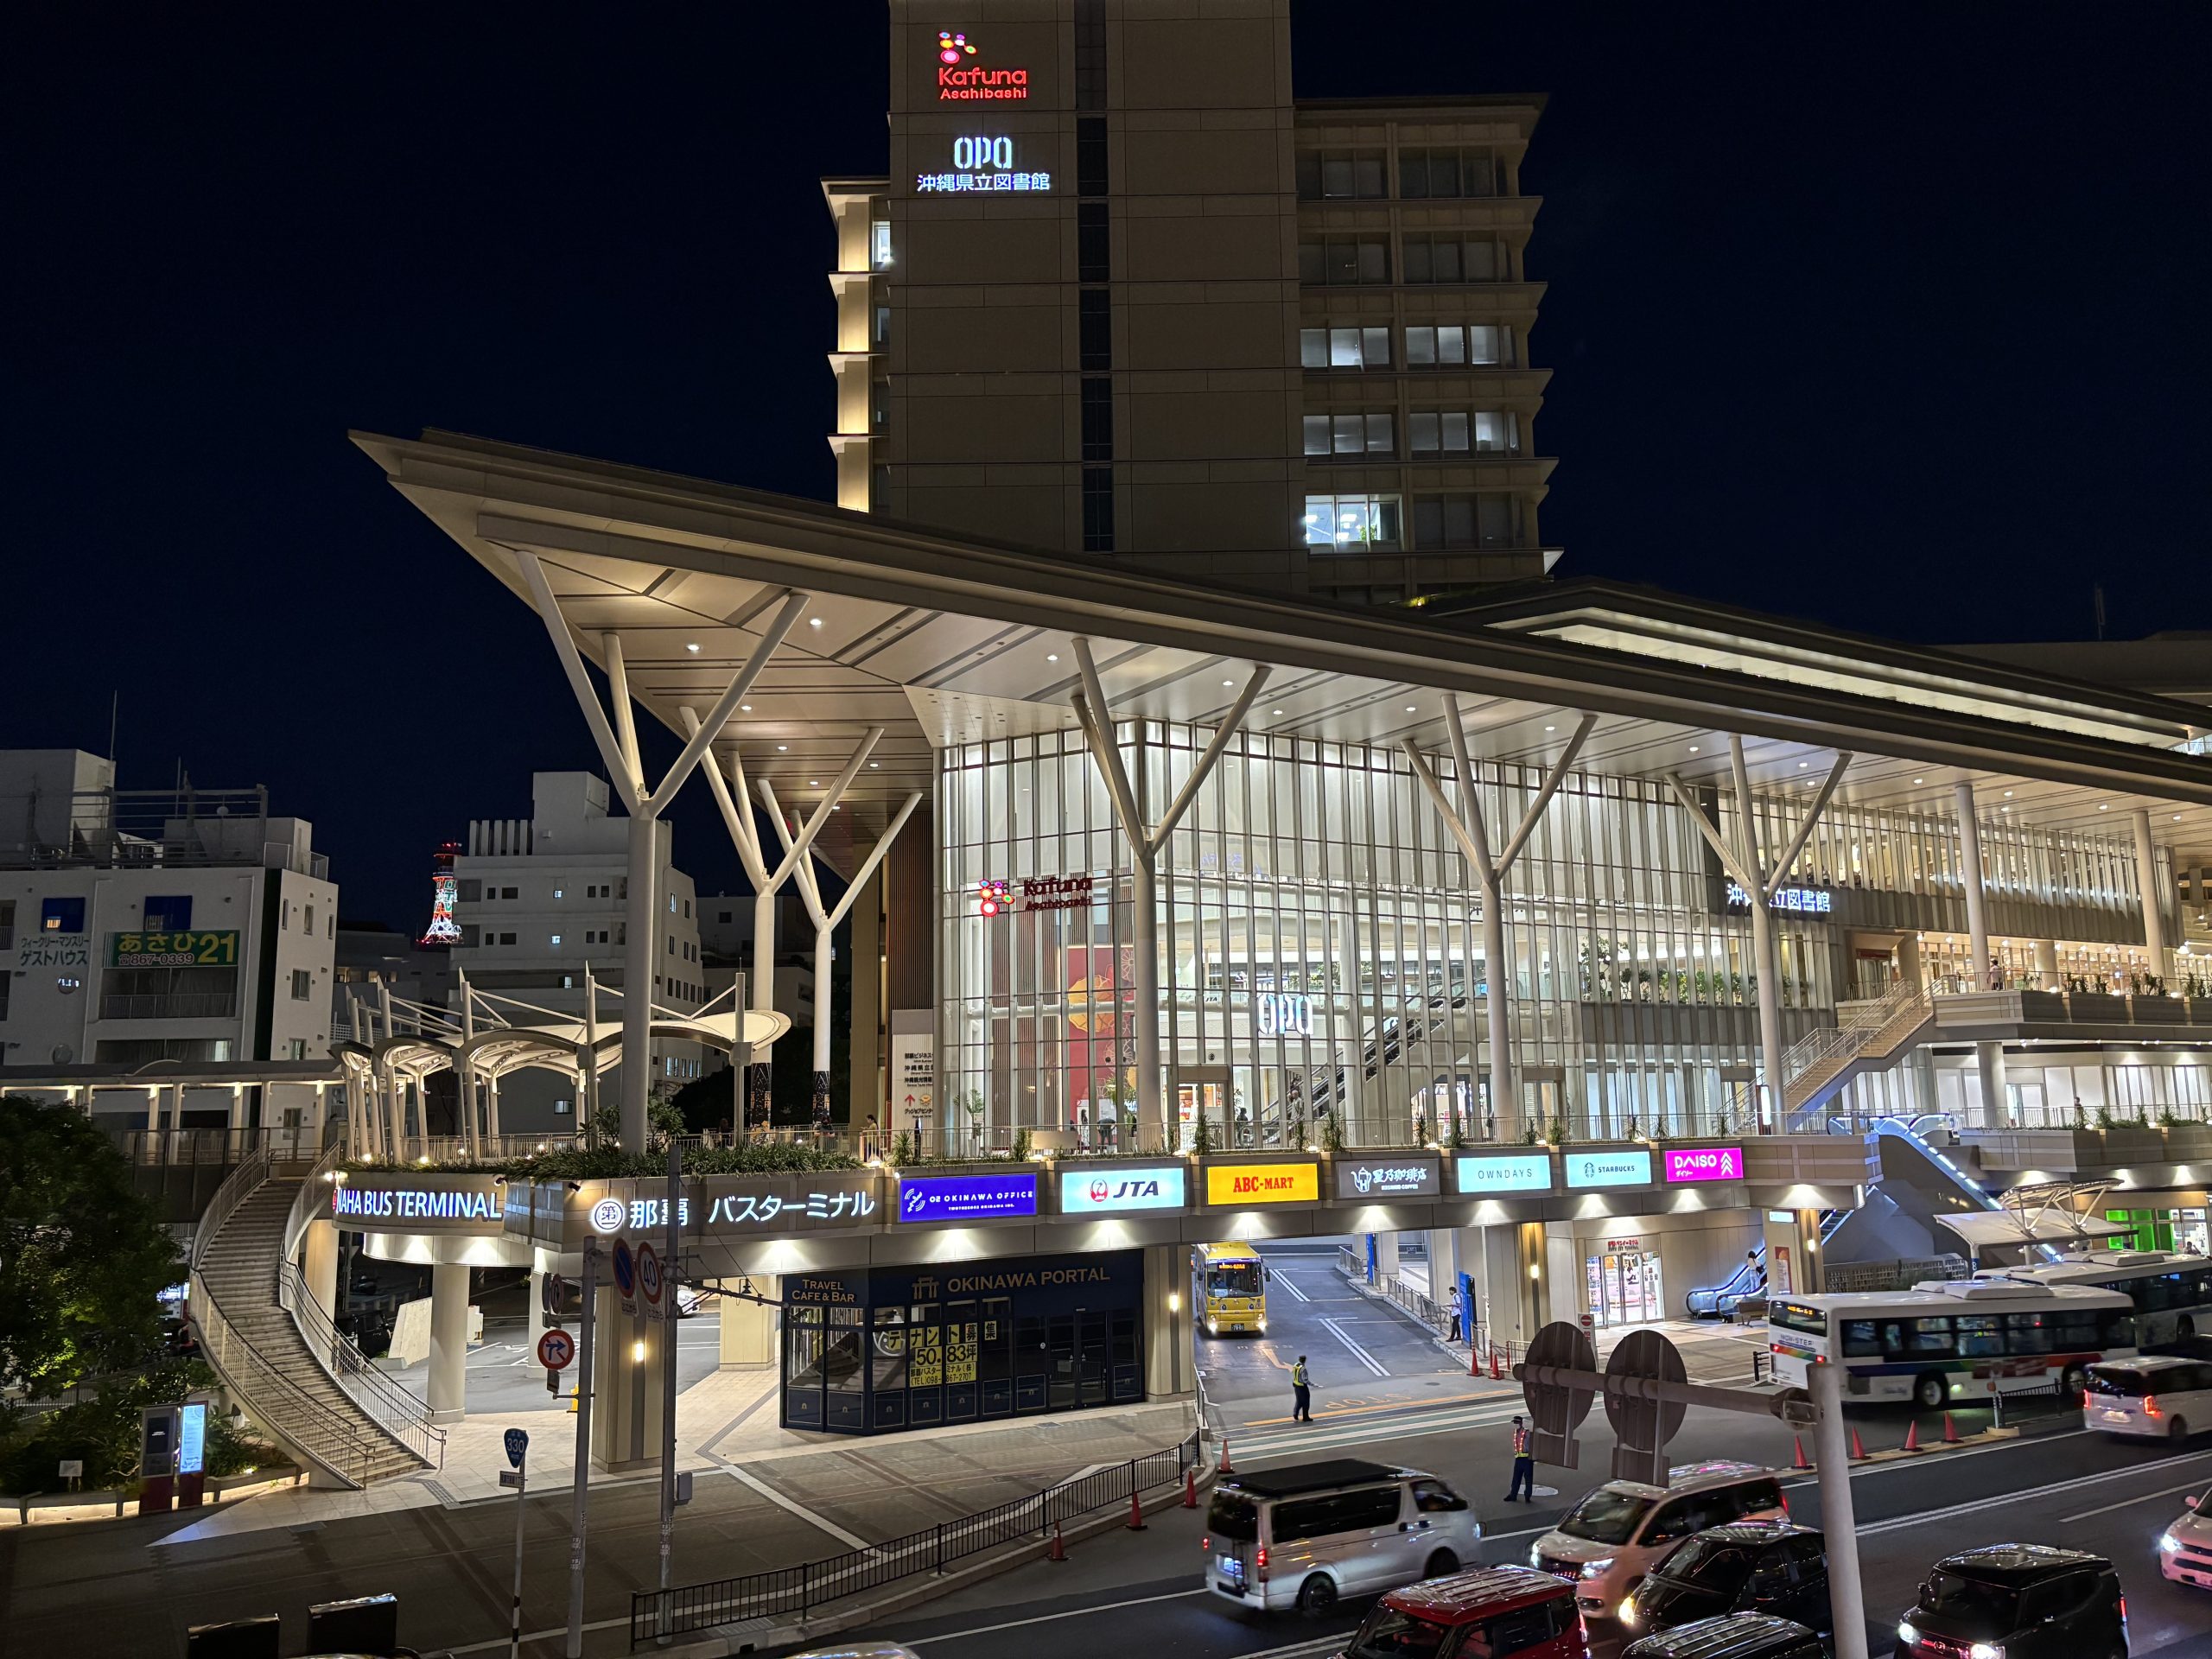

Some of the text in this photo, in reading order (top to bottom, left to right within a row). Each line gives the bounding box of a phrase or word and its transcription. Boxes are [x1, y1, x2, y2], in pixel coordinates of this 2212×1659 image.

[938, 67, 1027, 86] Kafuna
[940, 87, 1027, 99] Asahibashi
[917, 173, 1050, 192] 沖縄県立図書館
[1024, 877, 1092, 896] Kafuna
[1727, 883, 1830, 912] 沖立図書館
[21, 950, 87, 966] ゲストハウス
[1598, 1165, 1635, 1173] STARBUCKS
[1674, 1154, 1717, 1168] DAISO
[1478, 1169, 1533, 1180] OWNDAYS
[1113, 1180, 1159, 1198] JTA
[1233, 1175, 1294, 1193] ABC-MART
[337, 1188, 361, 1214] NAHA
[365, 1191, 392, 1216] BUS
[396, 1192, 502, 1218] TERMINAL
[944, 1193, 993, 1202] OKINAWA
[996, 1191, 1033, 1199] OFFICE
[709, 1191, 875, 1223] バスターミナル
[644, 1259, 656, 1287] 40
[947, 1267, 1110, 1294] OKINAWA PORTAL
[1325, 1392, 1413, 1410] STOP
[506, 1438, 524, 1453] 330
